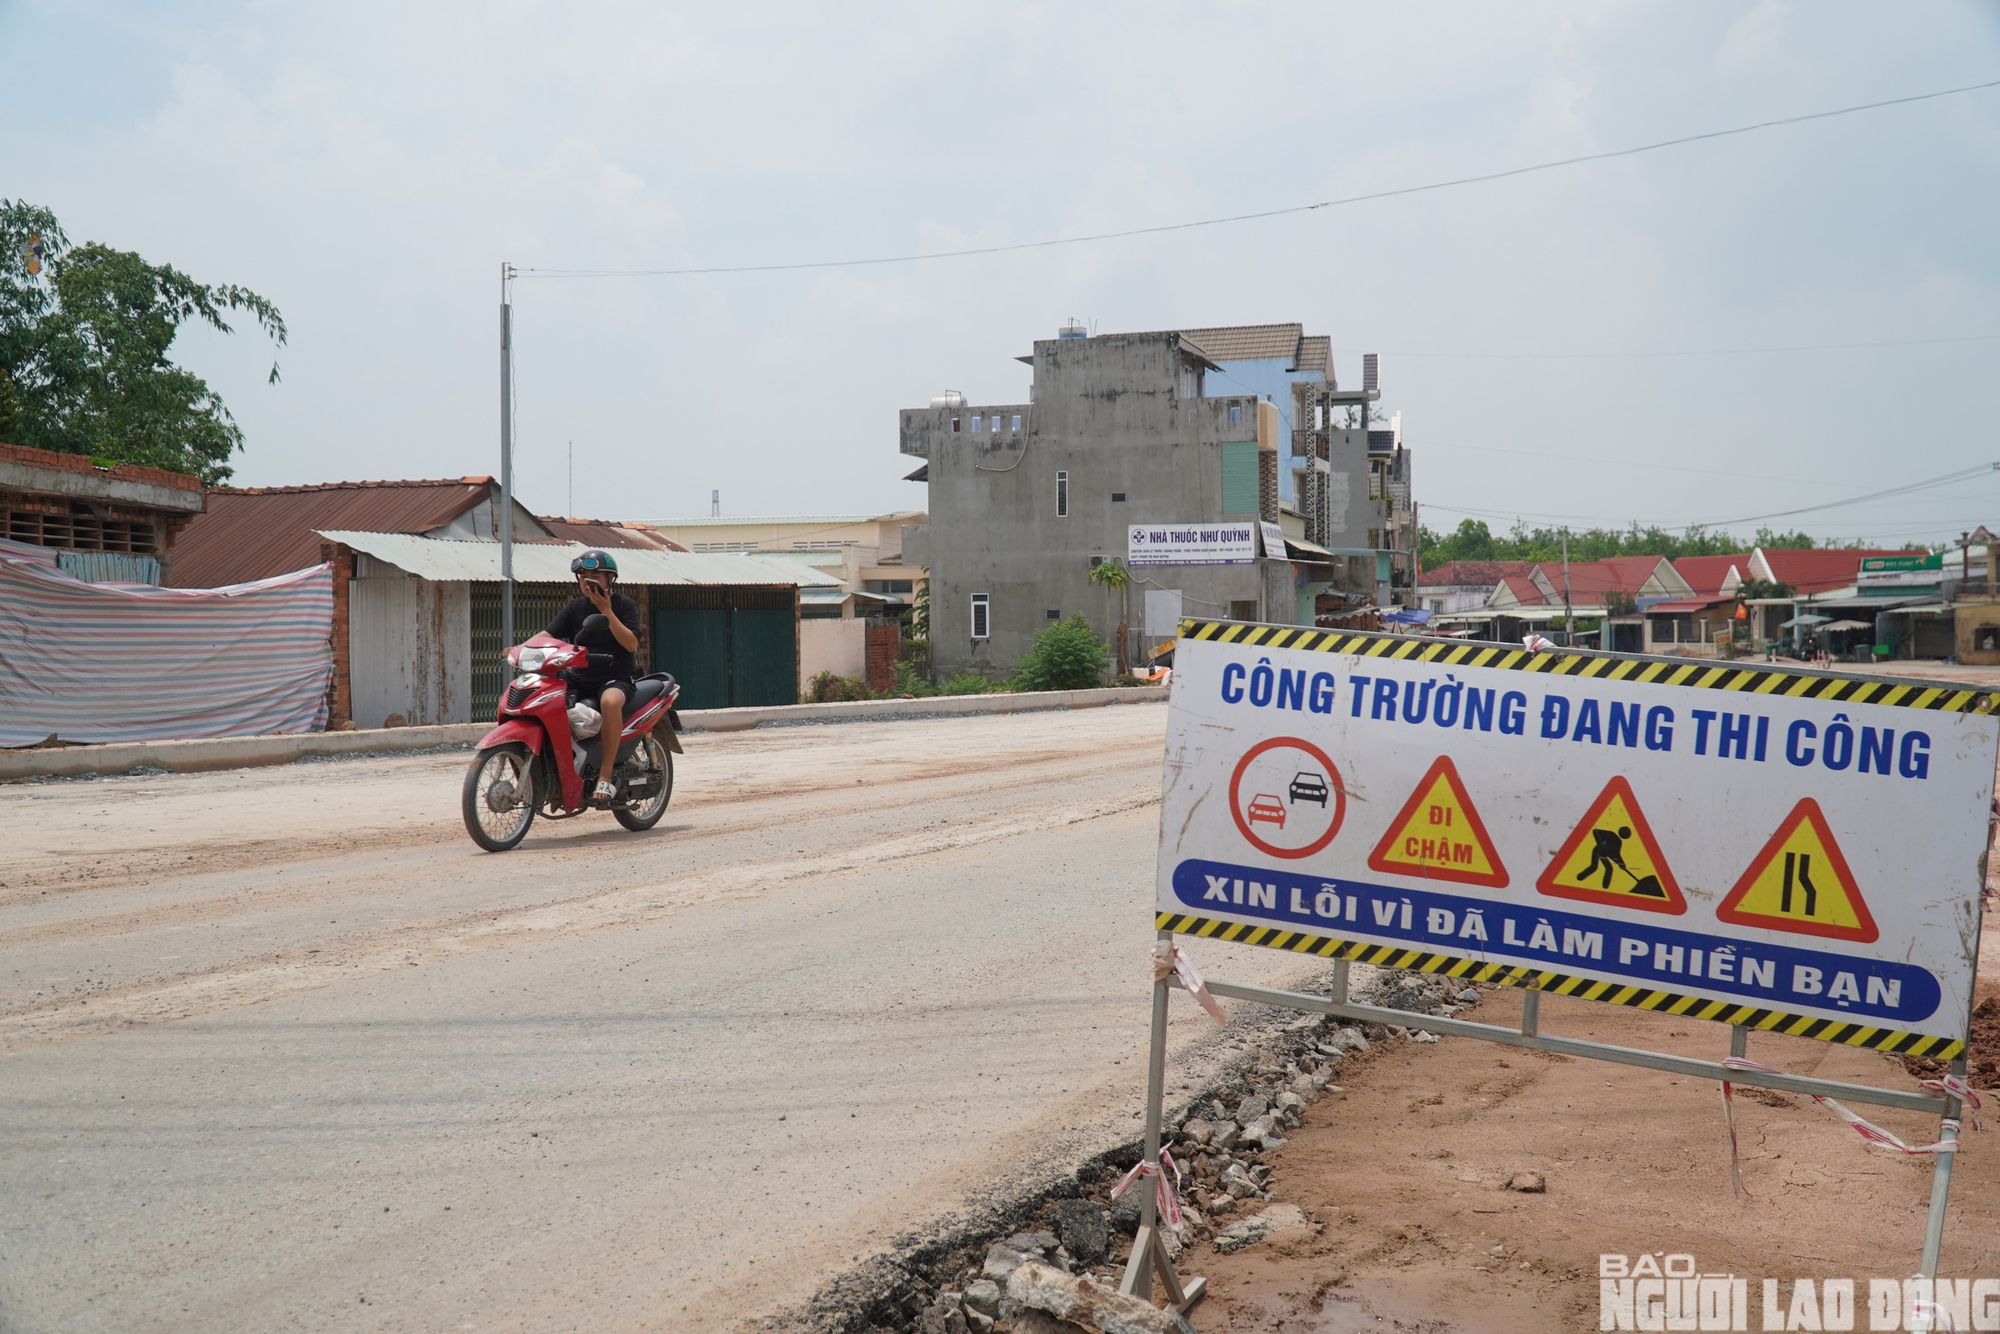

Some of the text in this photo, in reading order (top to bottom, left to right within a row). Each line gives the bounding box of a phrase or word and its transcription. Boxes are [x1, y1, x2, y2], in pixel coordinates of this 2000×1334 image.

[1150, 529, 1167, 543] NHÀ
[1170, 527, 1198, 543] THUỐC
[1200, 529, 1219, 543] NHƯ
[1221, 527, 1250, 543] QUỲNH
[1221, 657, 1931, 780] CÔNG TRƯỜNG ĐANG THI CÔNG
[1429, 805, 1452, 827] ĐI
[1405, 836, 1473, 865] CHẬM
[1203, 875, 1902, 1008] XIN LỖI VÌ ĐÃ LÀM PHIỀN BẠN
